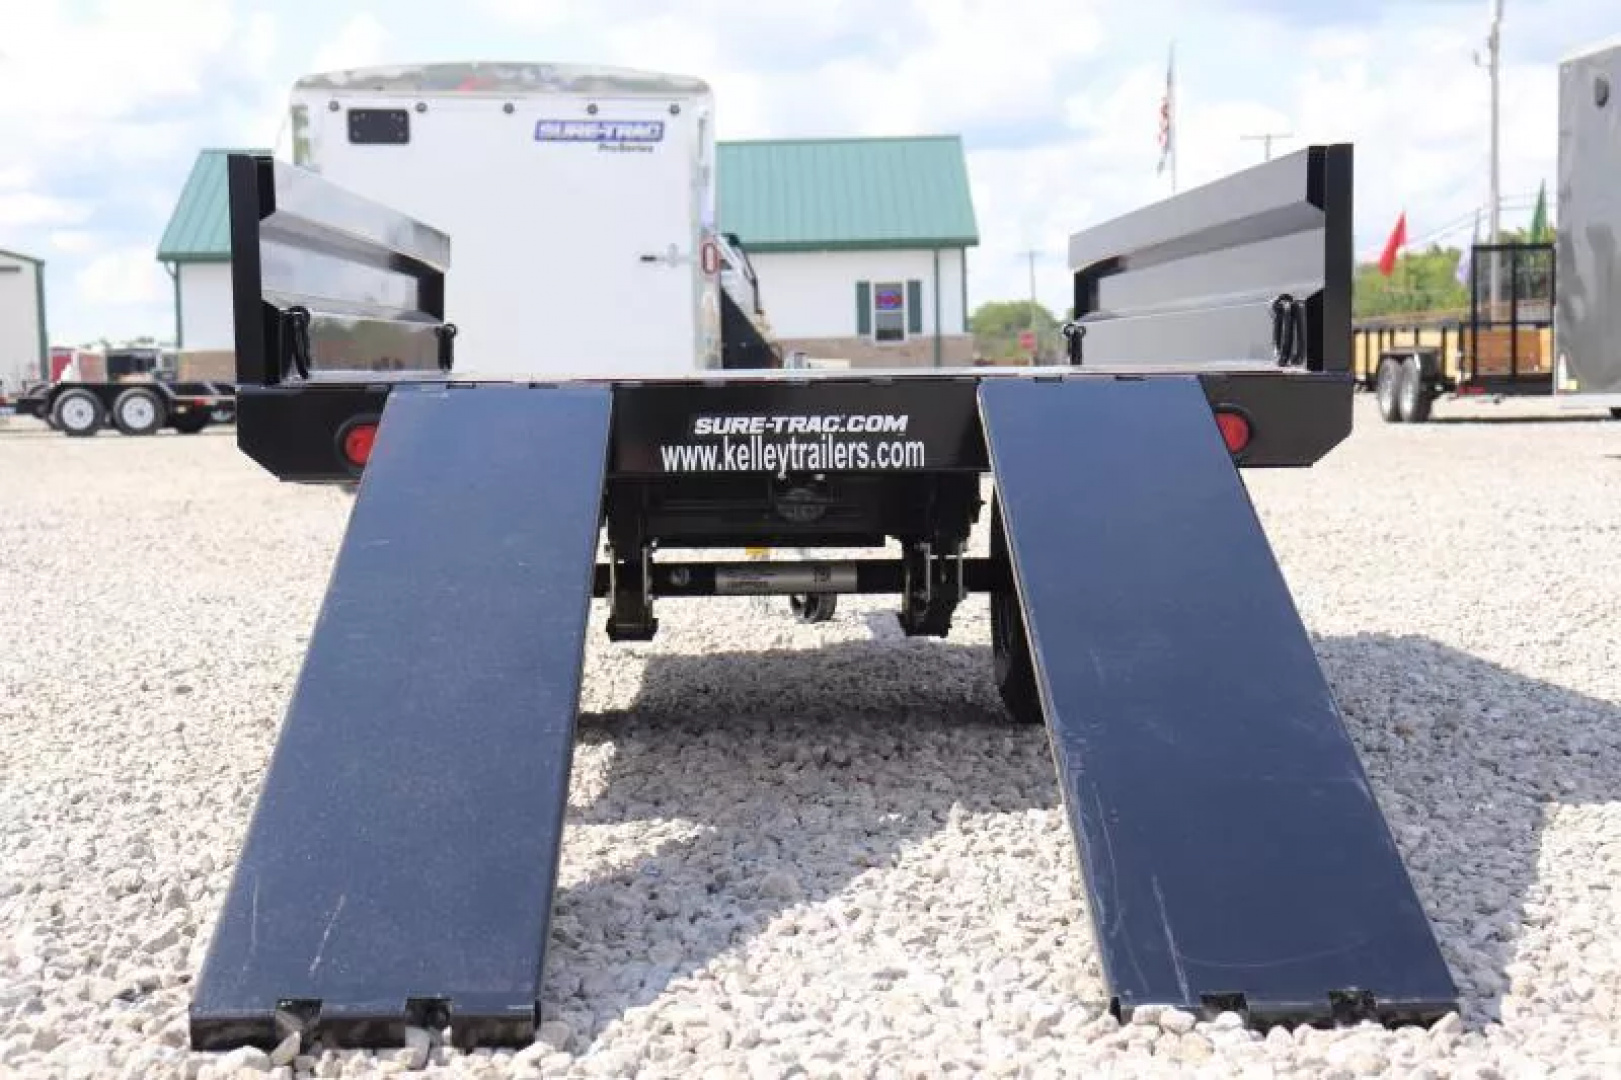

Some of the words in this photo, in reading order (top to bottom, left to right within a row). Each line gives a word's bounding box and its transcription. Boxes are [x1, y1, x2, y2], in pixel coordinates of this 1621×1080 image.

[537, 122, 661, 140] SURE-TRAC
[694, 414, 909, 435] SURE-TRAC.COM
[660, 434, 925, 478] www.kelleytrailers.com
